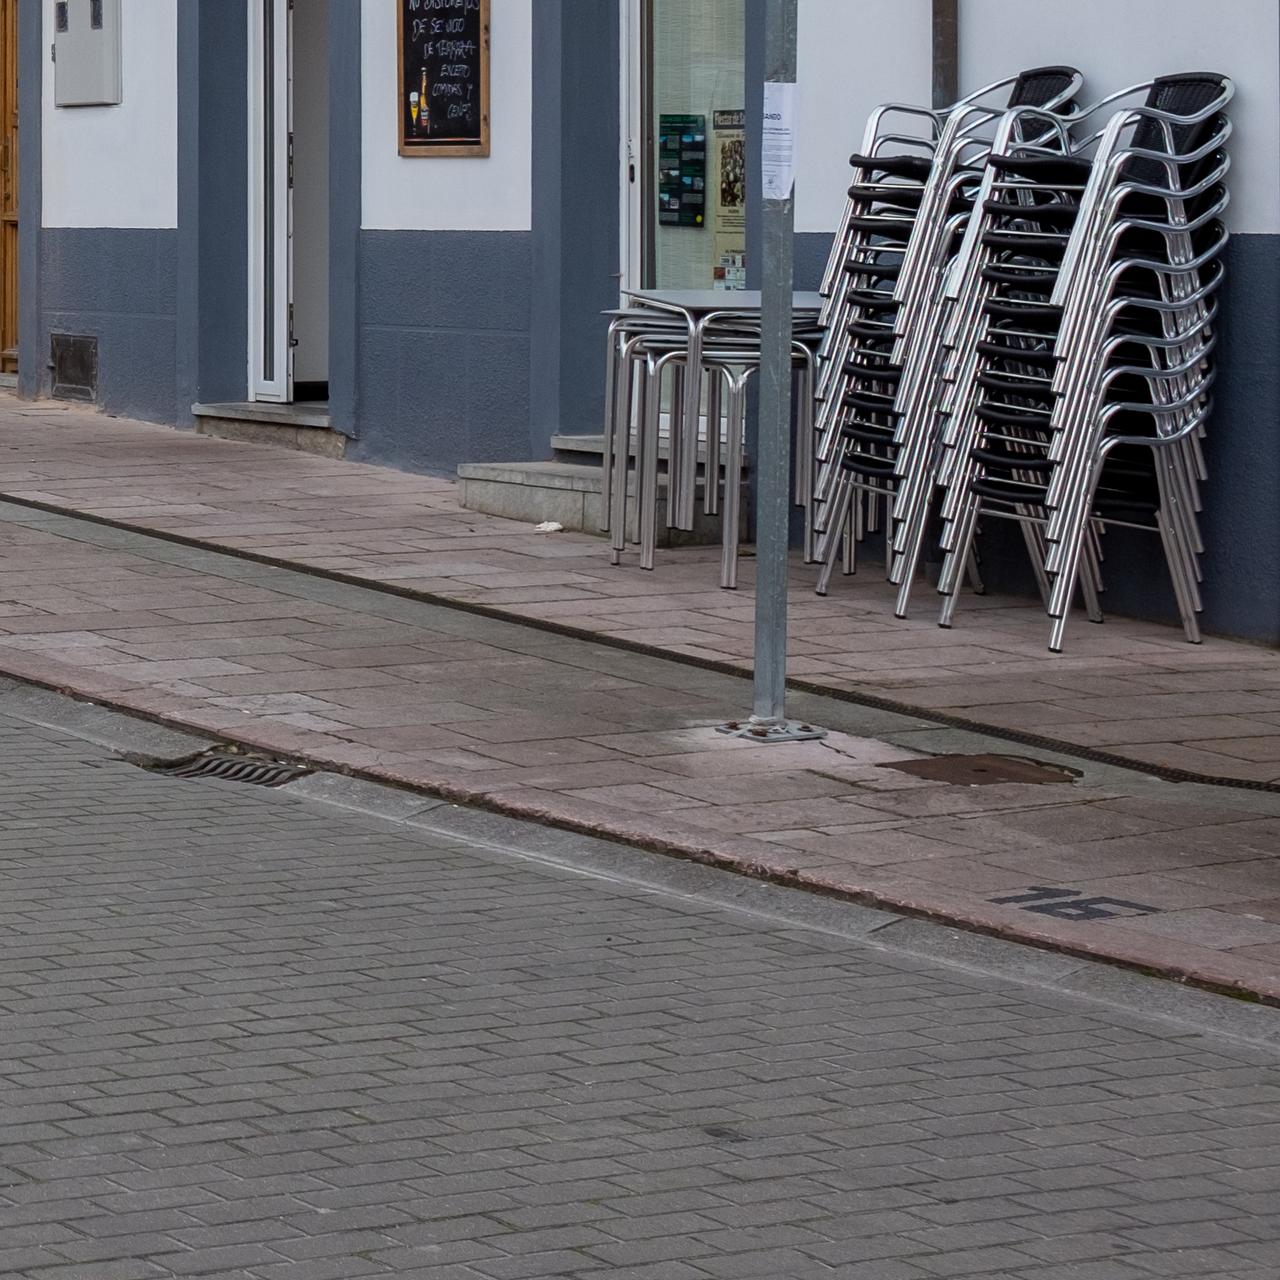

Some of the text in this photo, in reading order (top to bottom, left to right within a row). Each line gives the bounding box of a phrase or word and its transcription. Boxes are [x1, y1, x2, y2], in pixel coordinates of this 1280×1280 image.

[412, 18, 428, 42] DE
[424, 41, 434, 60] DE
[985, 886, 1163, 921] 16
